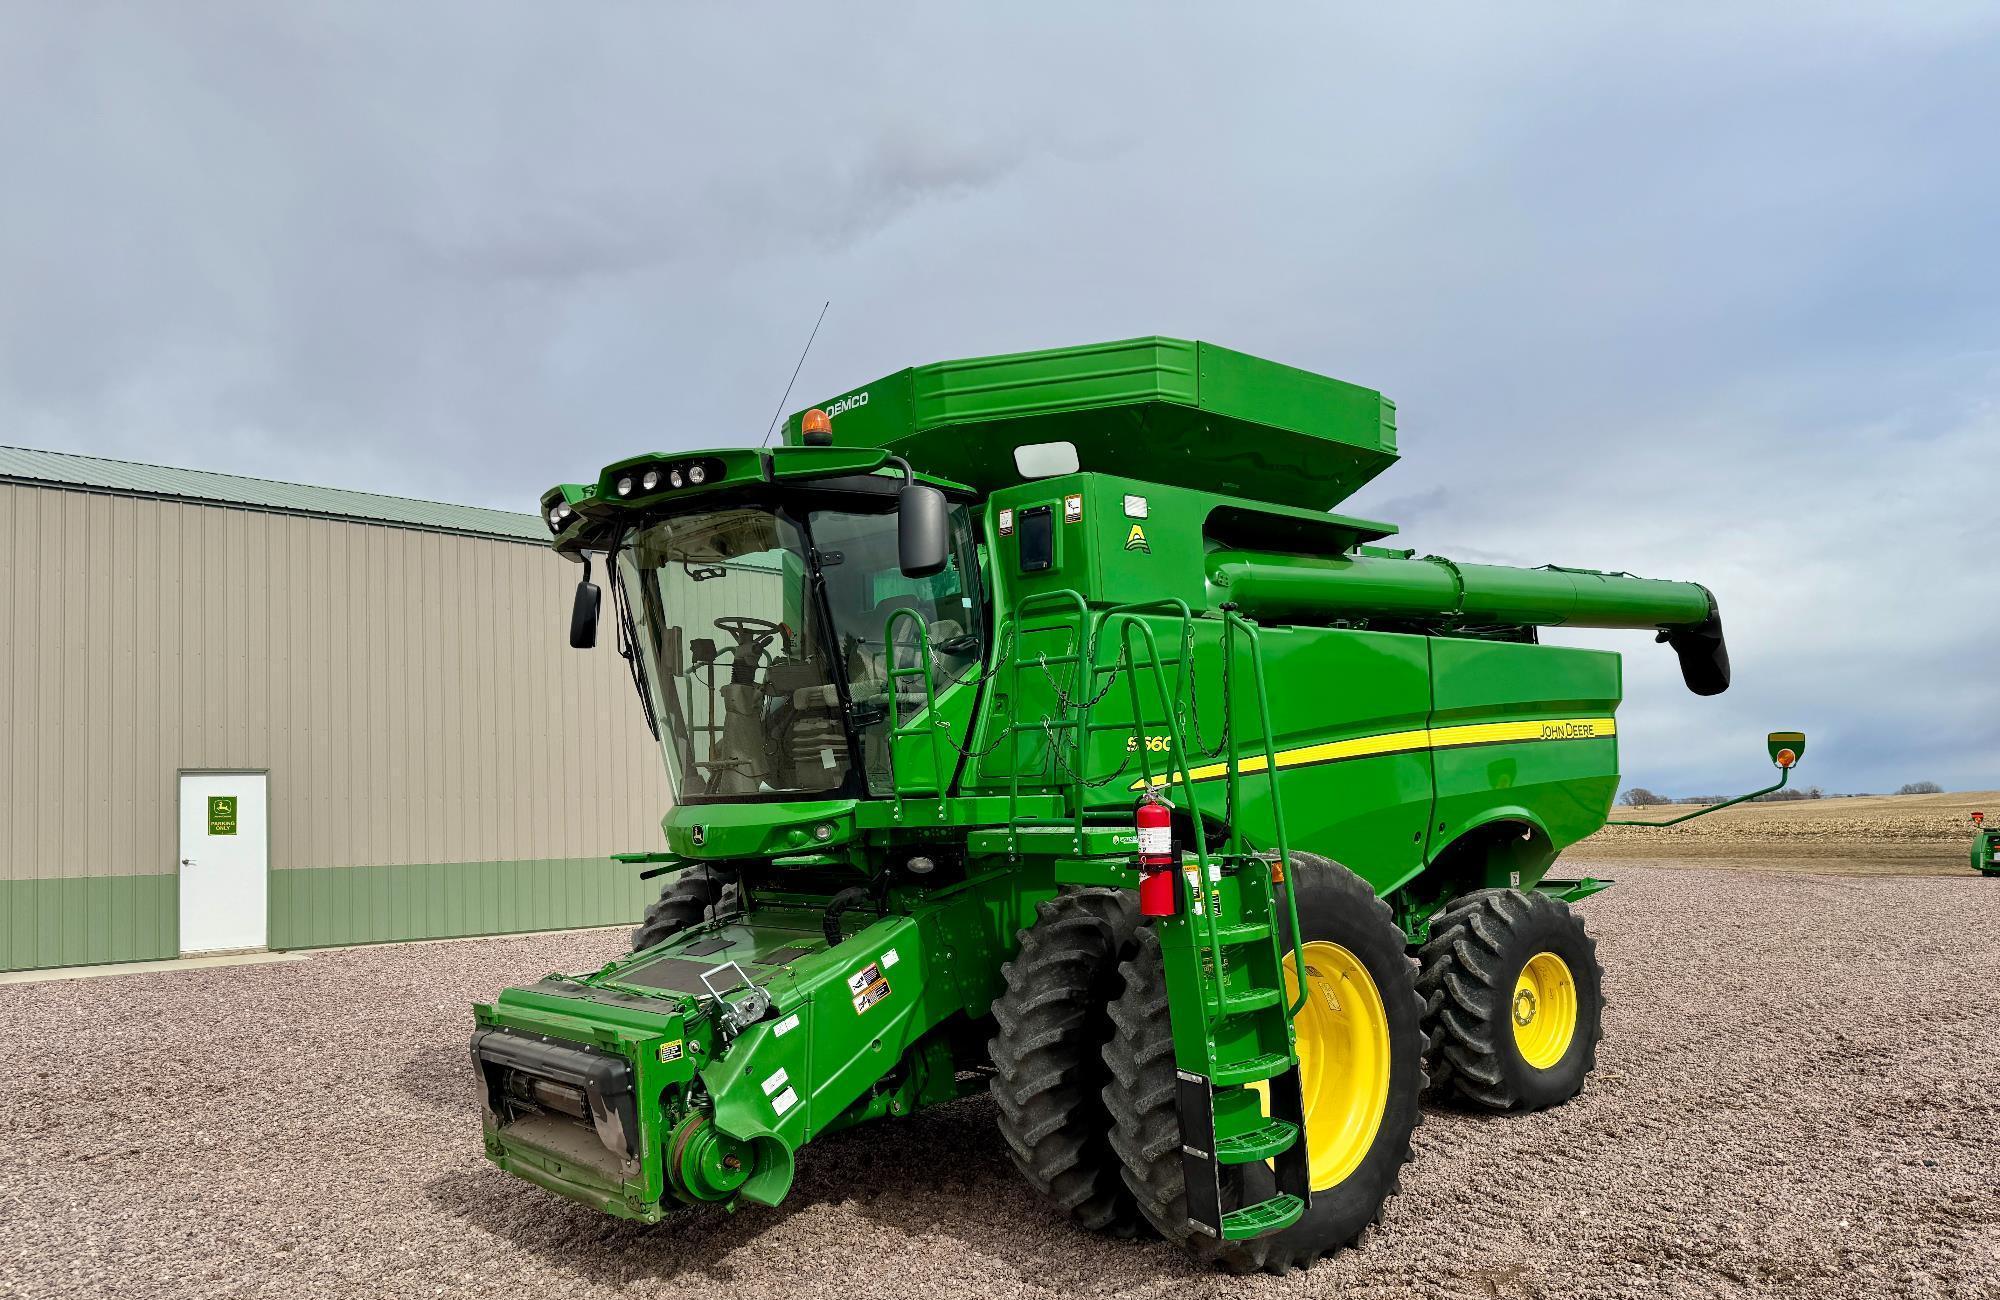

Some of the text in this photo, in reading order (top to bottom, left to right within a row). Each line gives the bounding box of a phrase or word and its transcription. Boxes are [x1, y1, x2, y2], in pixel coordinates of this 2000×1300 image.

[826, 392, 869, 420] DEMCO
[1540, 723, 1595, 738] JOHN DEERE
